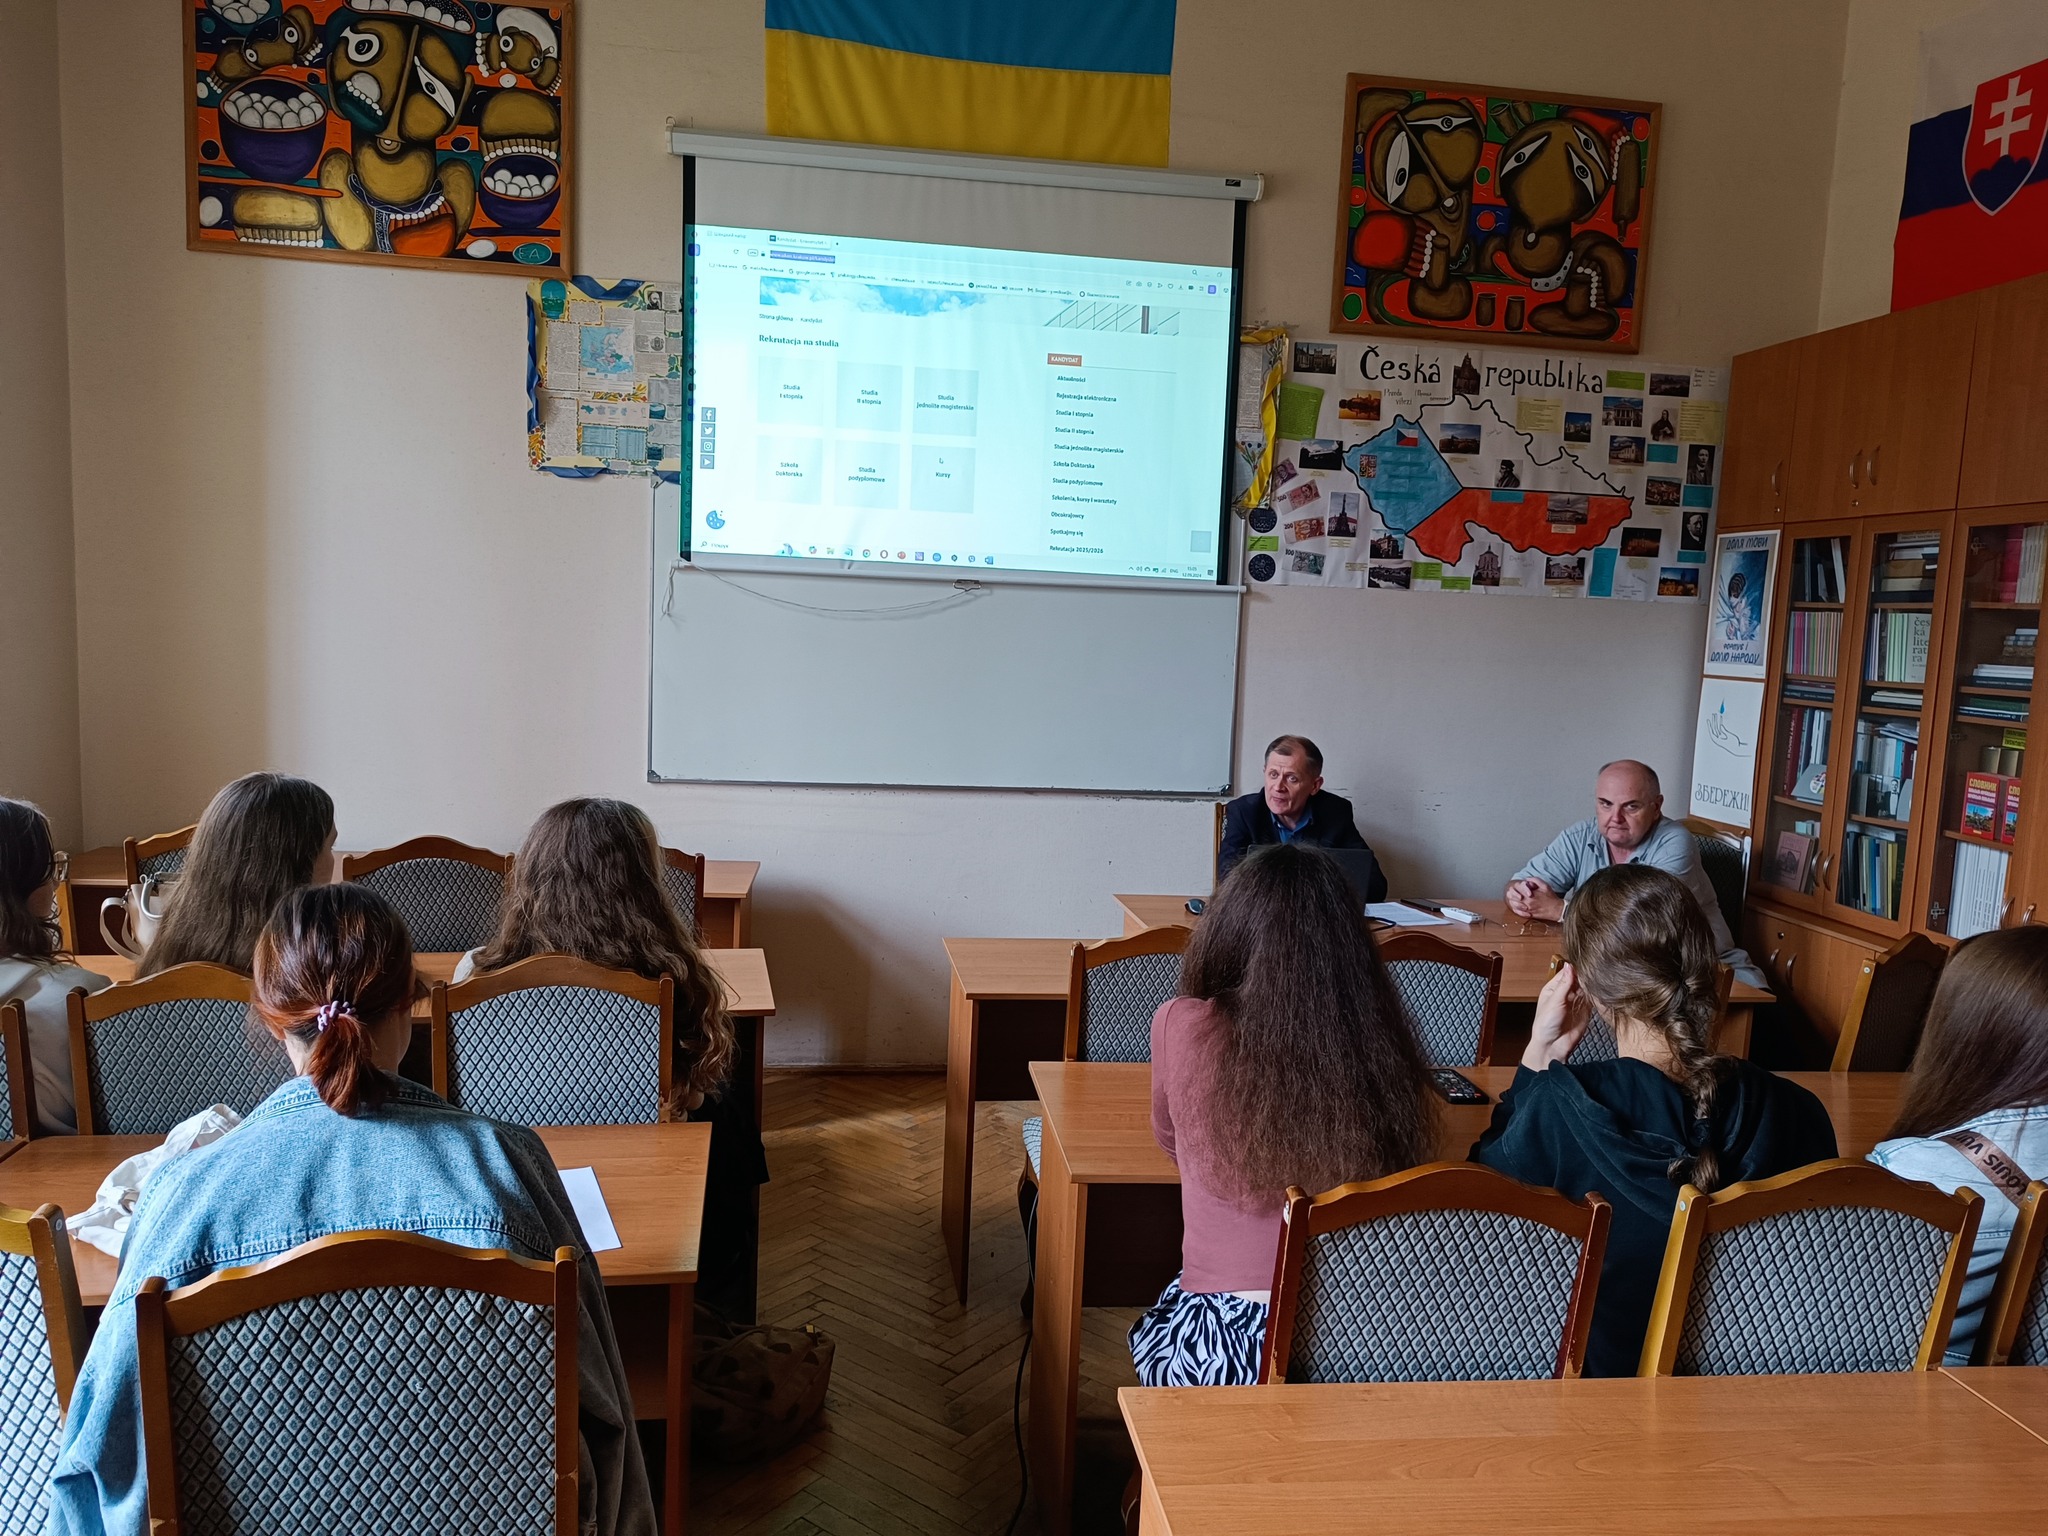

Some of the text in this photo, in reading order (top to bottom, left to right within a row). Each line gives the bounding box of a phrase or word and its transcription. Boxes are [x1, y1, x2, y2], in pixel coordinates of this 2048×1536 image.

[776, 314, 793, 322] główna
[759, 334, 839, 348] Rekrutacja na studia
[1050, 356, 1079, 364] KANDYDAT
[1360, 345, 1603, 395] Česká republika
[1057, 375, 1086, 383] Aktualności
[783, 383, 800, 391] Studia
[783, 392, 803, 400] stopnia
[861, 388, 878, 396] Studia
[1056, 392, 1117, 402] Rejestracja elektroniczna
[861, 398, 882, 406] stopnia
[916, 401, 974, 411] jednolite magisterskie
[1075, 410, 1094, 418] stopnia
[1076, 427, 1094, 435] stopnia
[1070, 444, 1093, 452] jednolite
[1093, 445, 1124, 454] magisterskie
[1070, 461, 1095, 469] Doktorska
[775, 470, 803, 478] Doktorska
[935, 471, 951, 479] Kursy
[848, 475, 886, 484] podyplomowe
[1069, 478, 1104, 487] podyplomowe
[1051, 494, 1076, 502] Szkolenia,
[1076, 496, 1090, 504] kursy
[1093, 497, 1118, 505] warsztaty
[1277, 494, 1288, 503] 500
[1050, 511, 1084, 520] Obcokrajowcy
[1283, 522, 1294, 530] 200
[1050, 528, 1076, 537] Spotkajmy
[1725, 536, 1769, 550] ДОЛЯ МОВИ
[1049, 545, 1075, 554] Rekrutacja
[1914, 616, 1930, 627] čes
[1913, 627, 1926, 636] ká
[1710, 651, 1760, 665] ДОЛЮ НАРОДУ
[1912, 654, 1923, 663] ra
[1968, 778, 1997, 791] СЛОВНИК
[1694, 783, 1750, 812] ЗБЕРЕЖИ!
[1984, 1155, 2027, 1195] LOUIS
